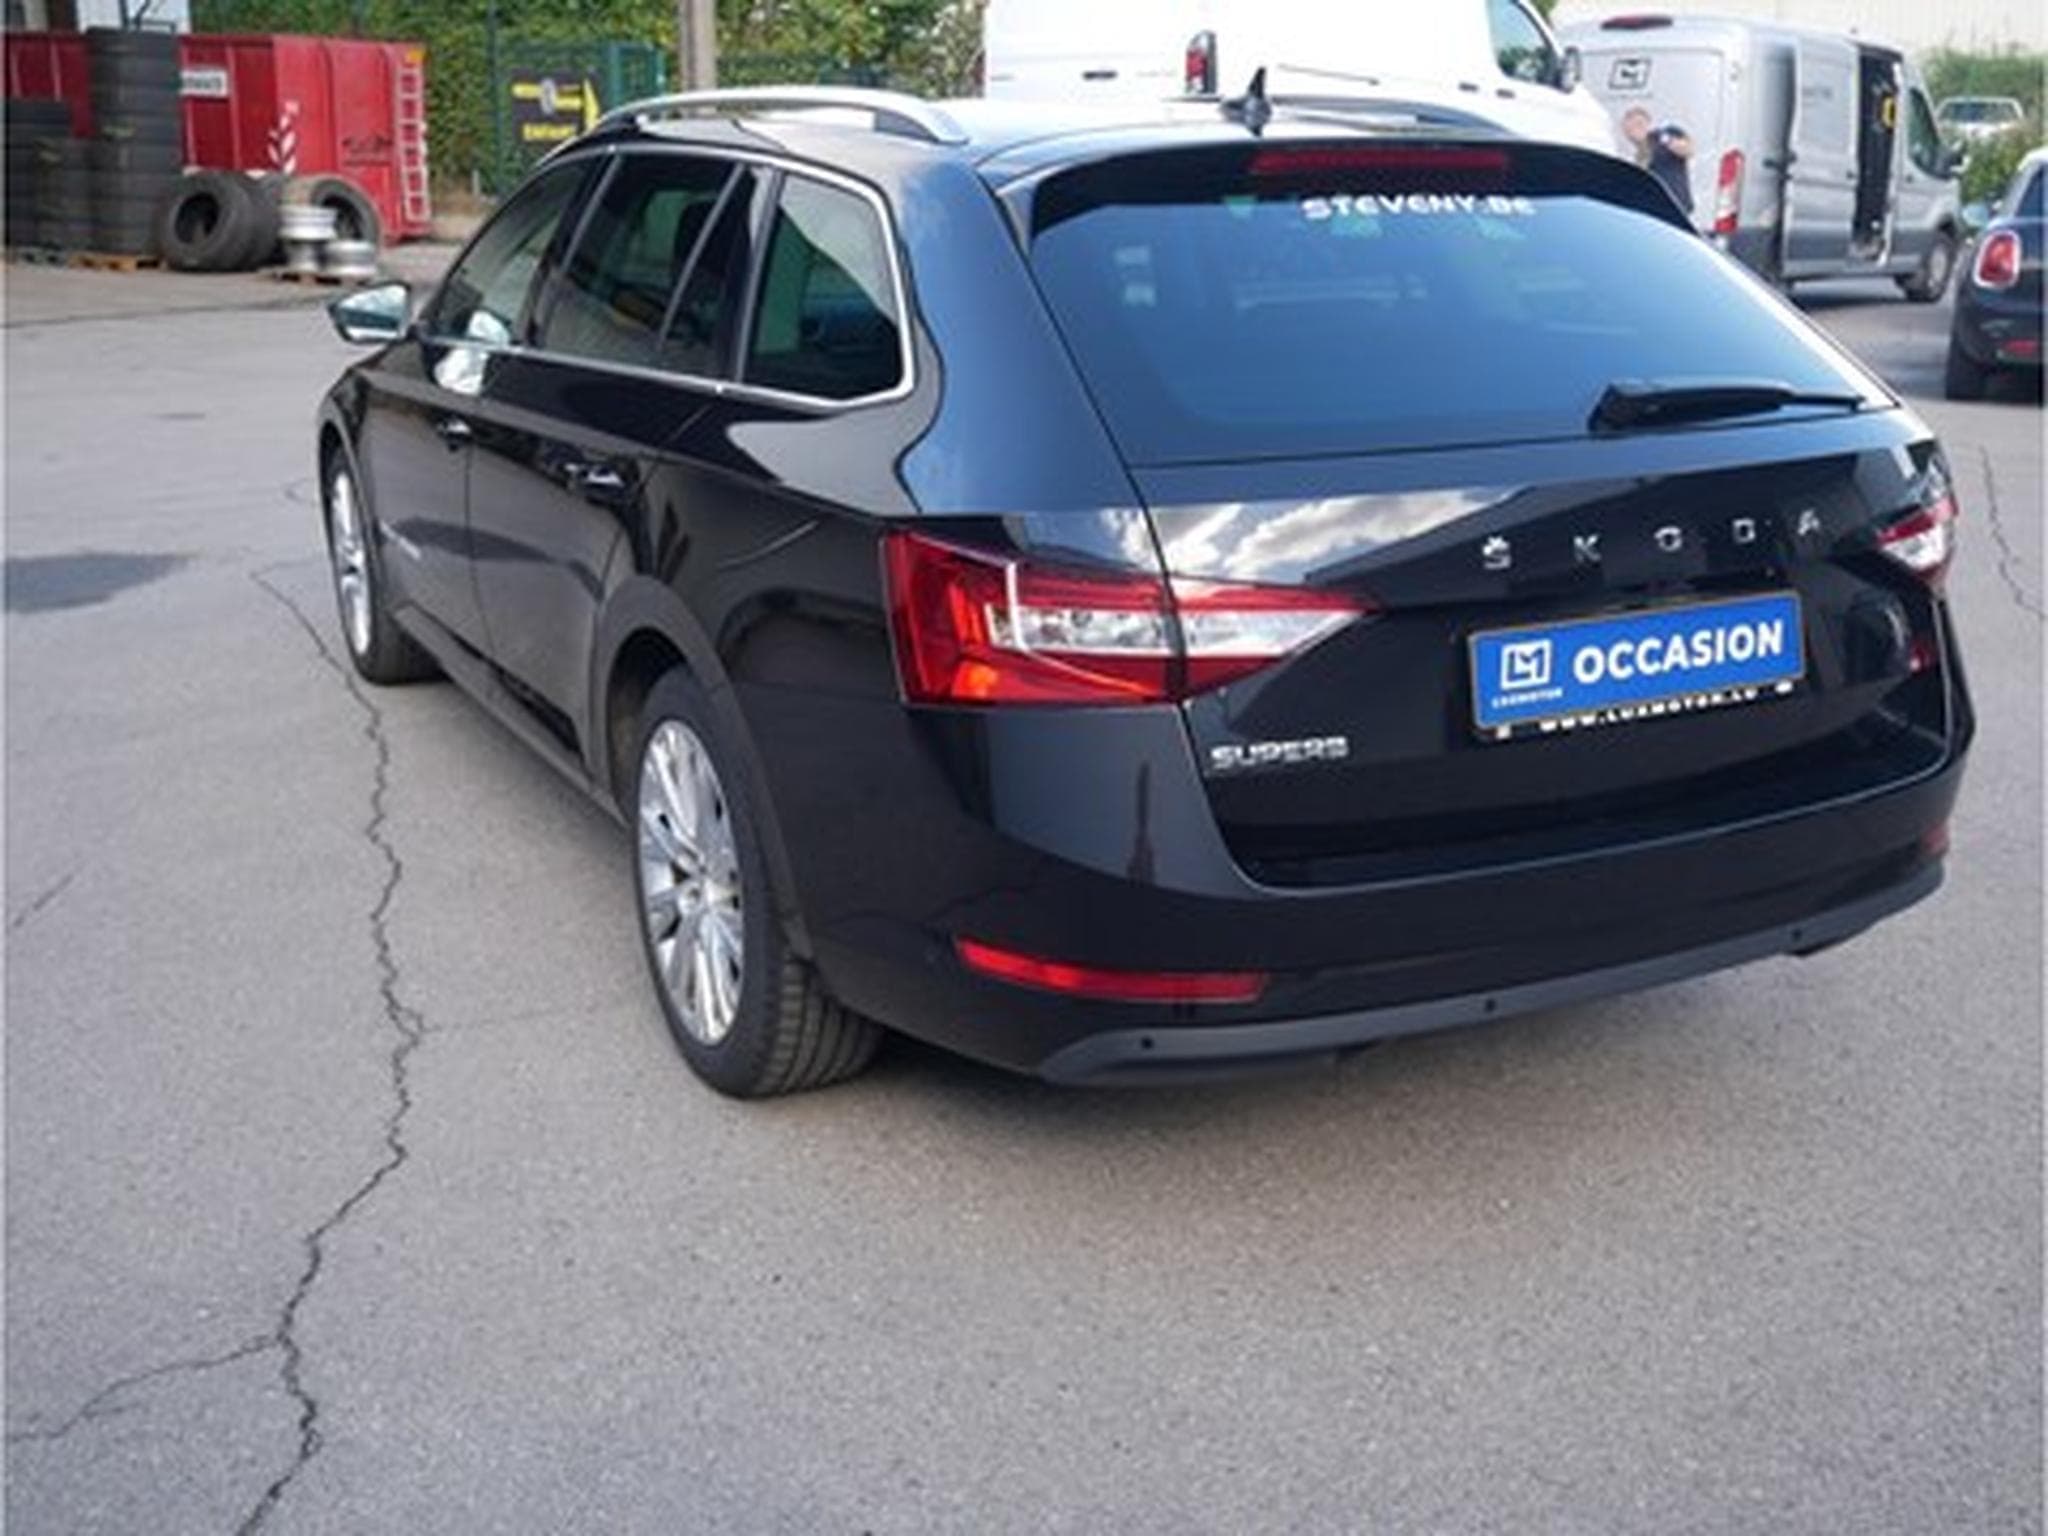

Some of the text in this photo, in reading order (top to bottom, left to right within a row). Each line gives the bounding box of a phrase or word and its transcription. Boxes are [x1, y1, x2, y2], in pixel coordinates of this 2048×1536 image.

[1303, 194, 1537, 220] STEVENY.DE
[1572, 618, 1784, 685] OCCASION
[1210, 735, 1348, 770] SUPERB
